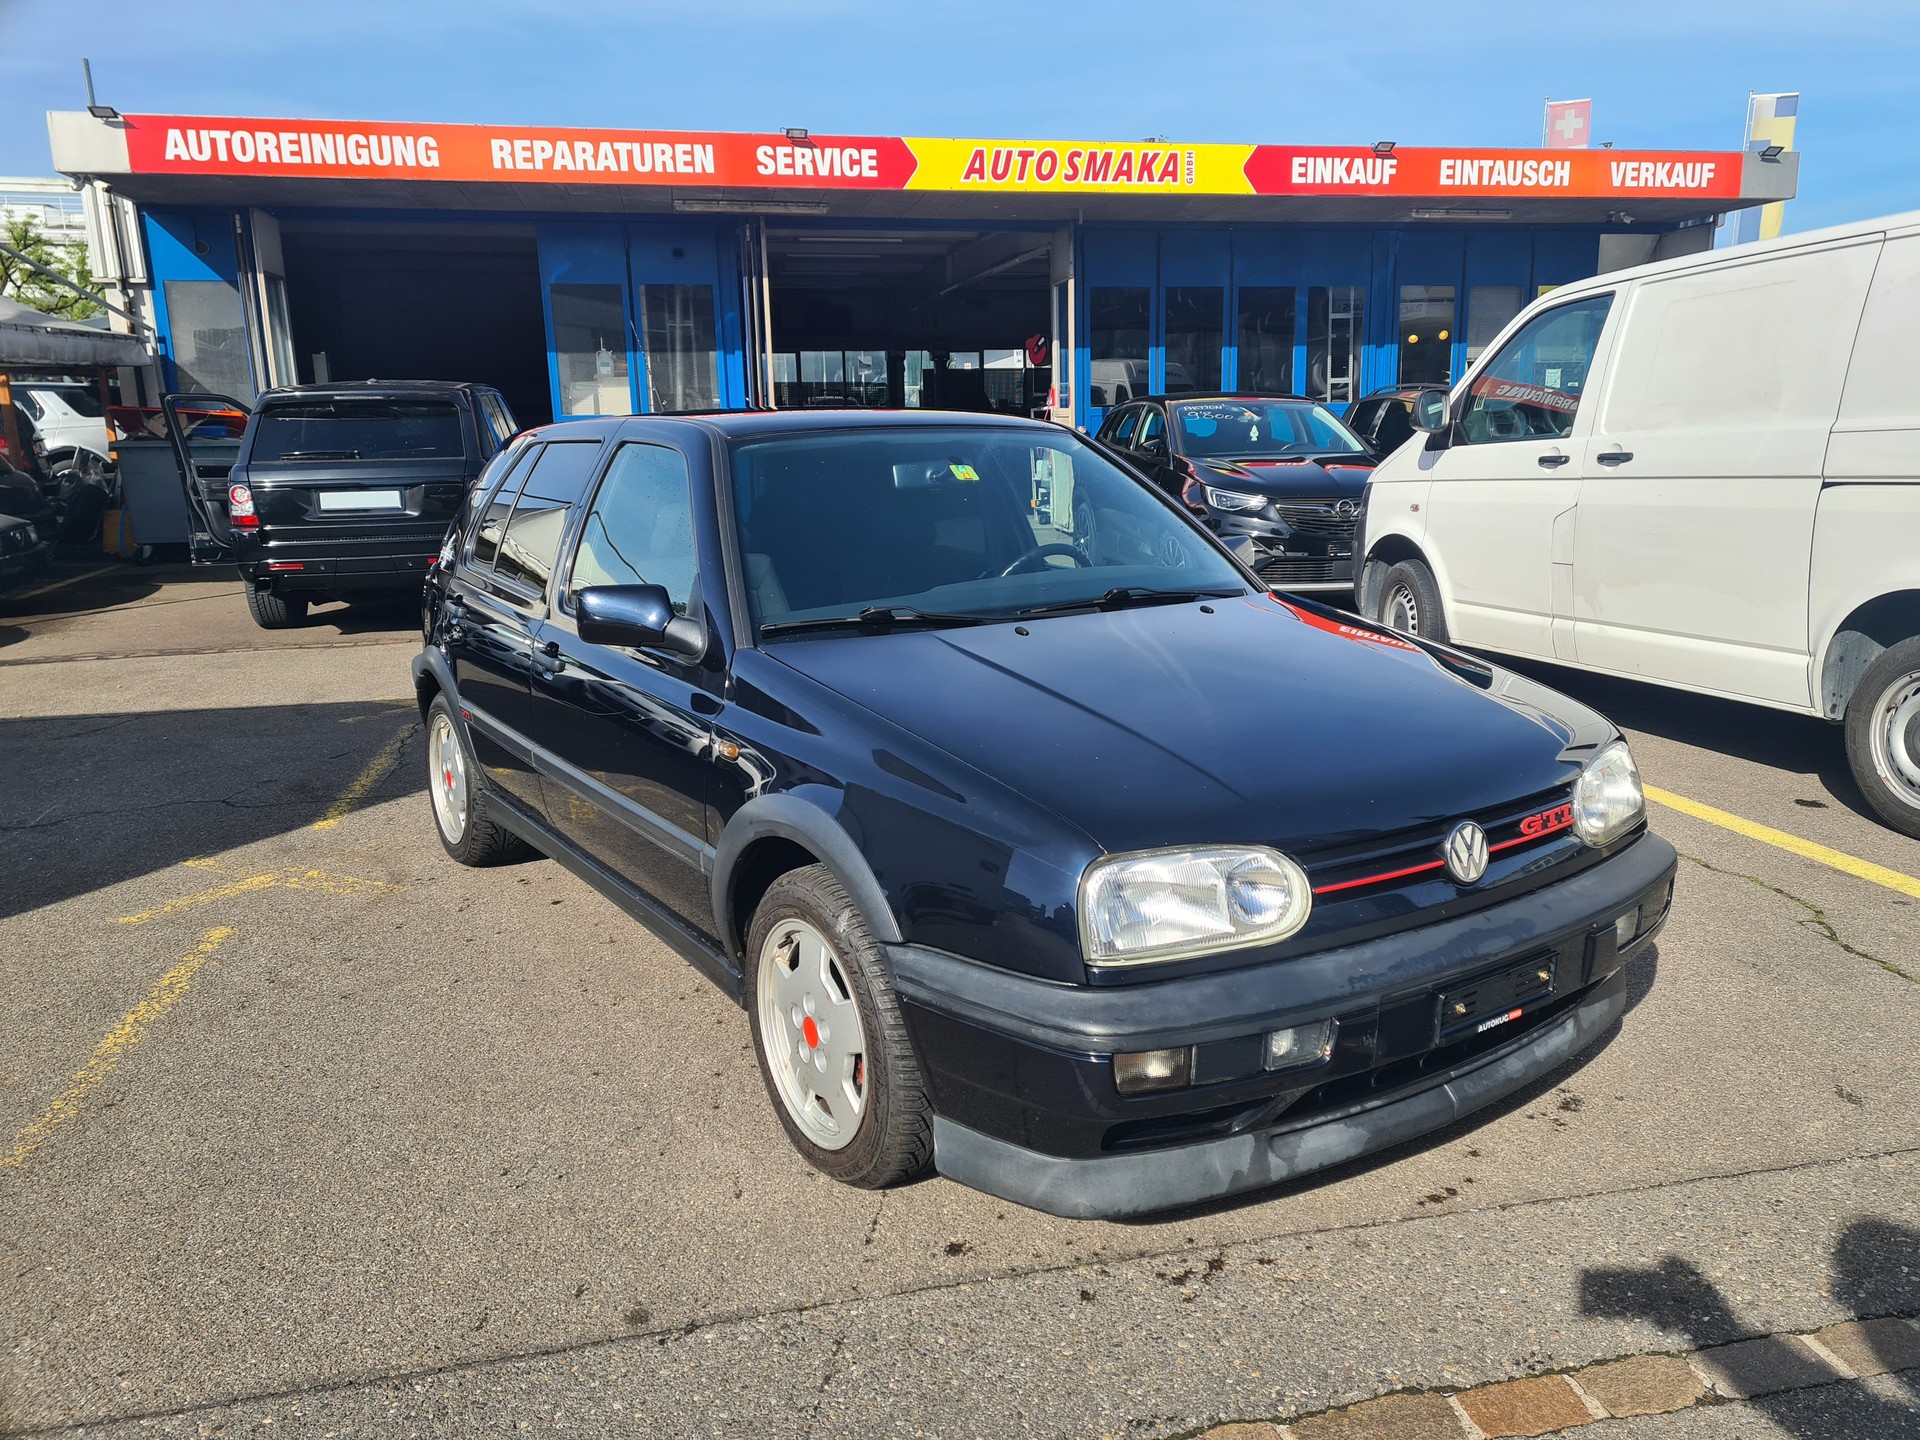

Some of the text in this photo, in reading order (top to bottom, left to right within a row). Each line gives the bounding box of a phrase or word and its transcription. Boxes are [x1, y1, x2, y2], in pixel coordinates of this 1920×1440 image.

[164, 128, 440, 168] AUTOREINIGUNG
[490, 138, 715, 174] REPARATUREN
[756, 145, 879, 178] SERVICE
[962, 148, 1180, 184] AUTO SMAKA
[1185, 151, 1195, 184] GMBH
[1291, 156, 1398, 185] EINKAUF
[1439, 159, 1571, 187] EINTAUSCH
[1610, 161, 1716, 188] VERKAUF
[1520, 803, 1574, 835] GTI
